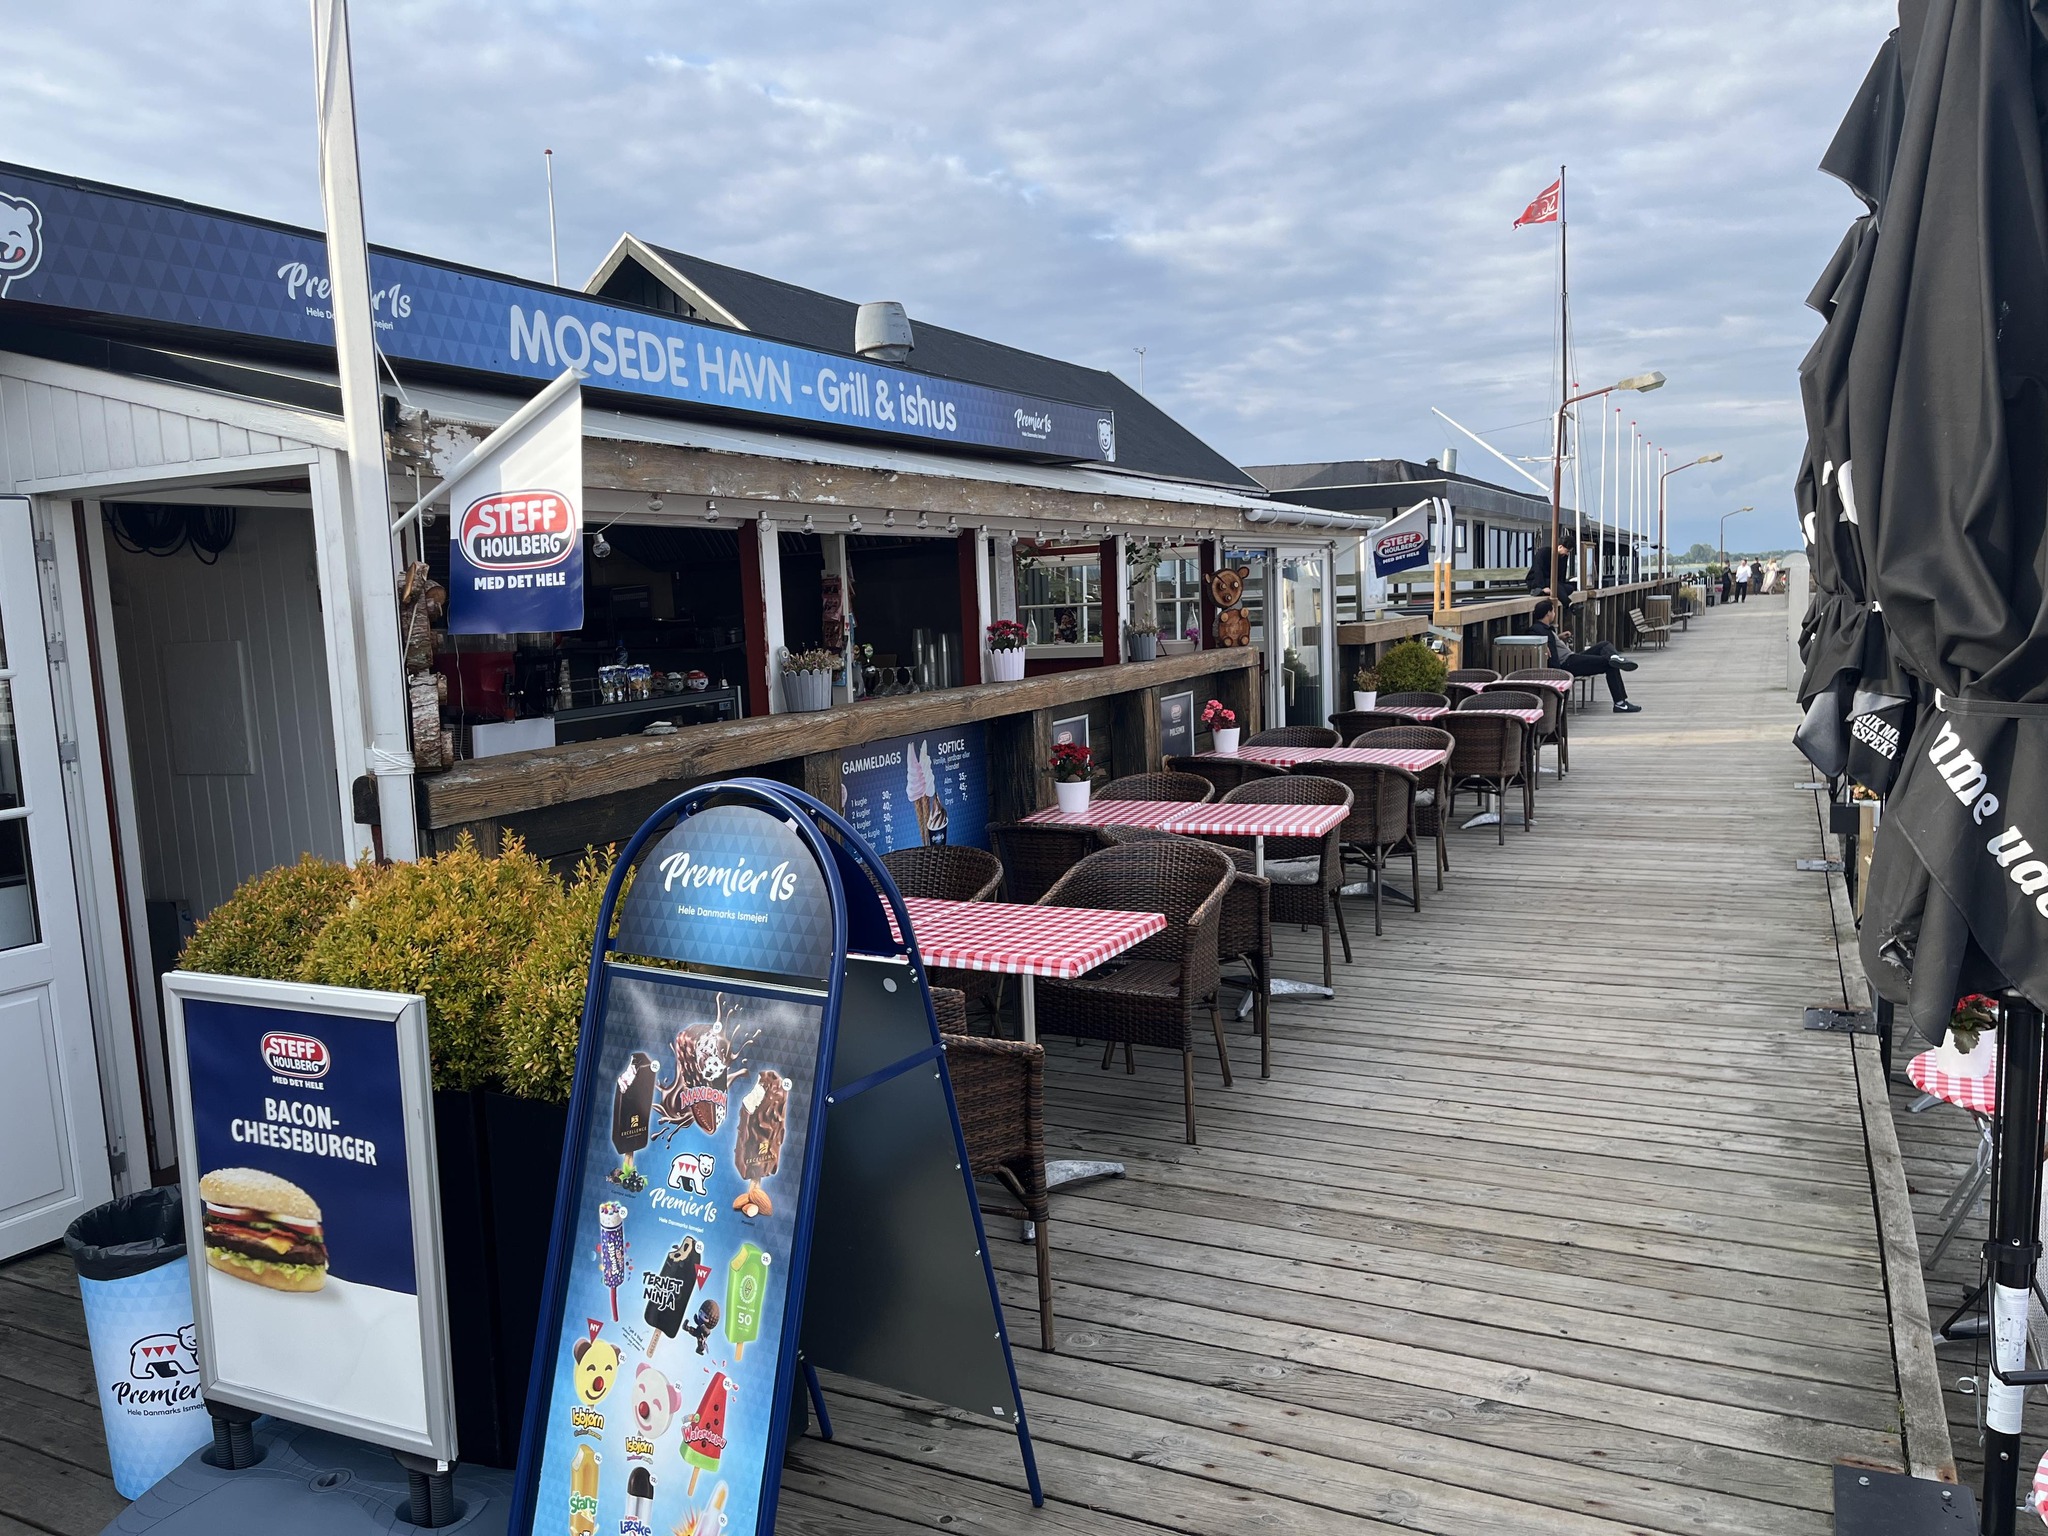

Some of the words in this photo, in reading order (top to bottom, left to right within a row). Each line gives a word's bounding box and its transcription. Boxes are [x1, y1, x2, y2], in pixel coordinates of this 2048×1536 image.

[388, 283, 411, 318] Is
[305, 306, 325, 318] Hele
[510, 304, 689, 387] MOSEDE
[696, 341, 793, 405] HAVN
[816, 367, 870, 416] Grill
[875, 384, 895, 422] &
[899, 386, 957, 432] ishus
[1014, 408, 1045, 431] Premier
[477, 498, 558, 535] STEFF
[480, 533, 561, 558] HOULBERG
[1383, 534, 1416, 547] STEFF
[473, 576, 505, 590] MED
[507, 574, 533, 588] DET
[535, 571, 566, 587] HELE
[937, 738, 965, 756] SOFTICE
[842, 751, 902, 775] GAMMELDAGS
[659, 851, 768, 898] Premier
[769, 860, 798, 902] Is
[678, 905, 695, 916] Hele
[697, 907, 736, 920] Danmarks
[737, 911, 769, 924] Ismejeri
[268, 1037, 316, 1059] STEFF
[272, 1055, 320, 1073] HOULBERG
[272, 1075, 289, 1085] MED
[289, 1078, 304, 1088] DET
[304, 1080, 324, 1090] HELE
[680, 1086, 728, 1110] MAXIBON
[264, 1097, 340, 1130] BACON-
[231, 1118, 377, 1166] CHEESEBURGER
[621, 1126, 647, 1137] EXCELLENCE
[649, 1187, 705, 1217] Premier
[703, 1201, 718, 1223] Is
[642, 1271, 684, 1295] TERNET
[697, 1269, 708, 1279] NY
[589, 1322, 600, 1333] NY
[737, 1312, 753, 1326] 50
[111, 1380, 201, 1407] Premier
[127, 1408, 142, 1416] Hele
[143, 1407, 181, 1416] Danmarks
[571, 1407, 605, 1430] Isbjørn
[625, 1436, 654, 1456] Isbjørn
